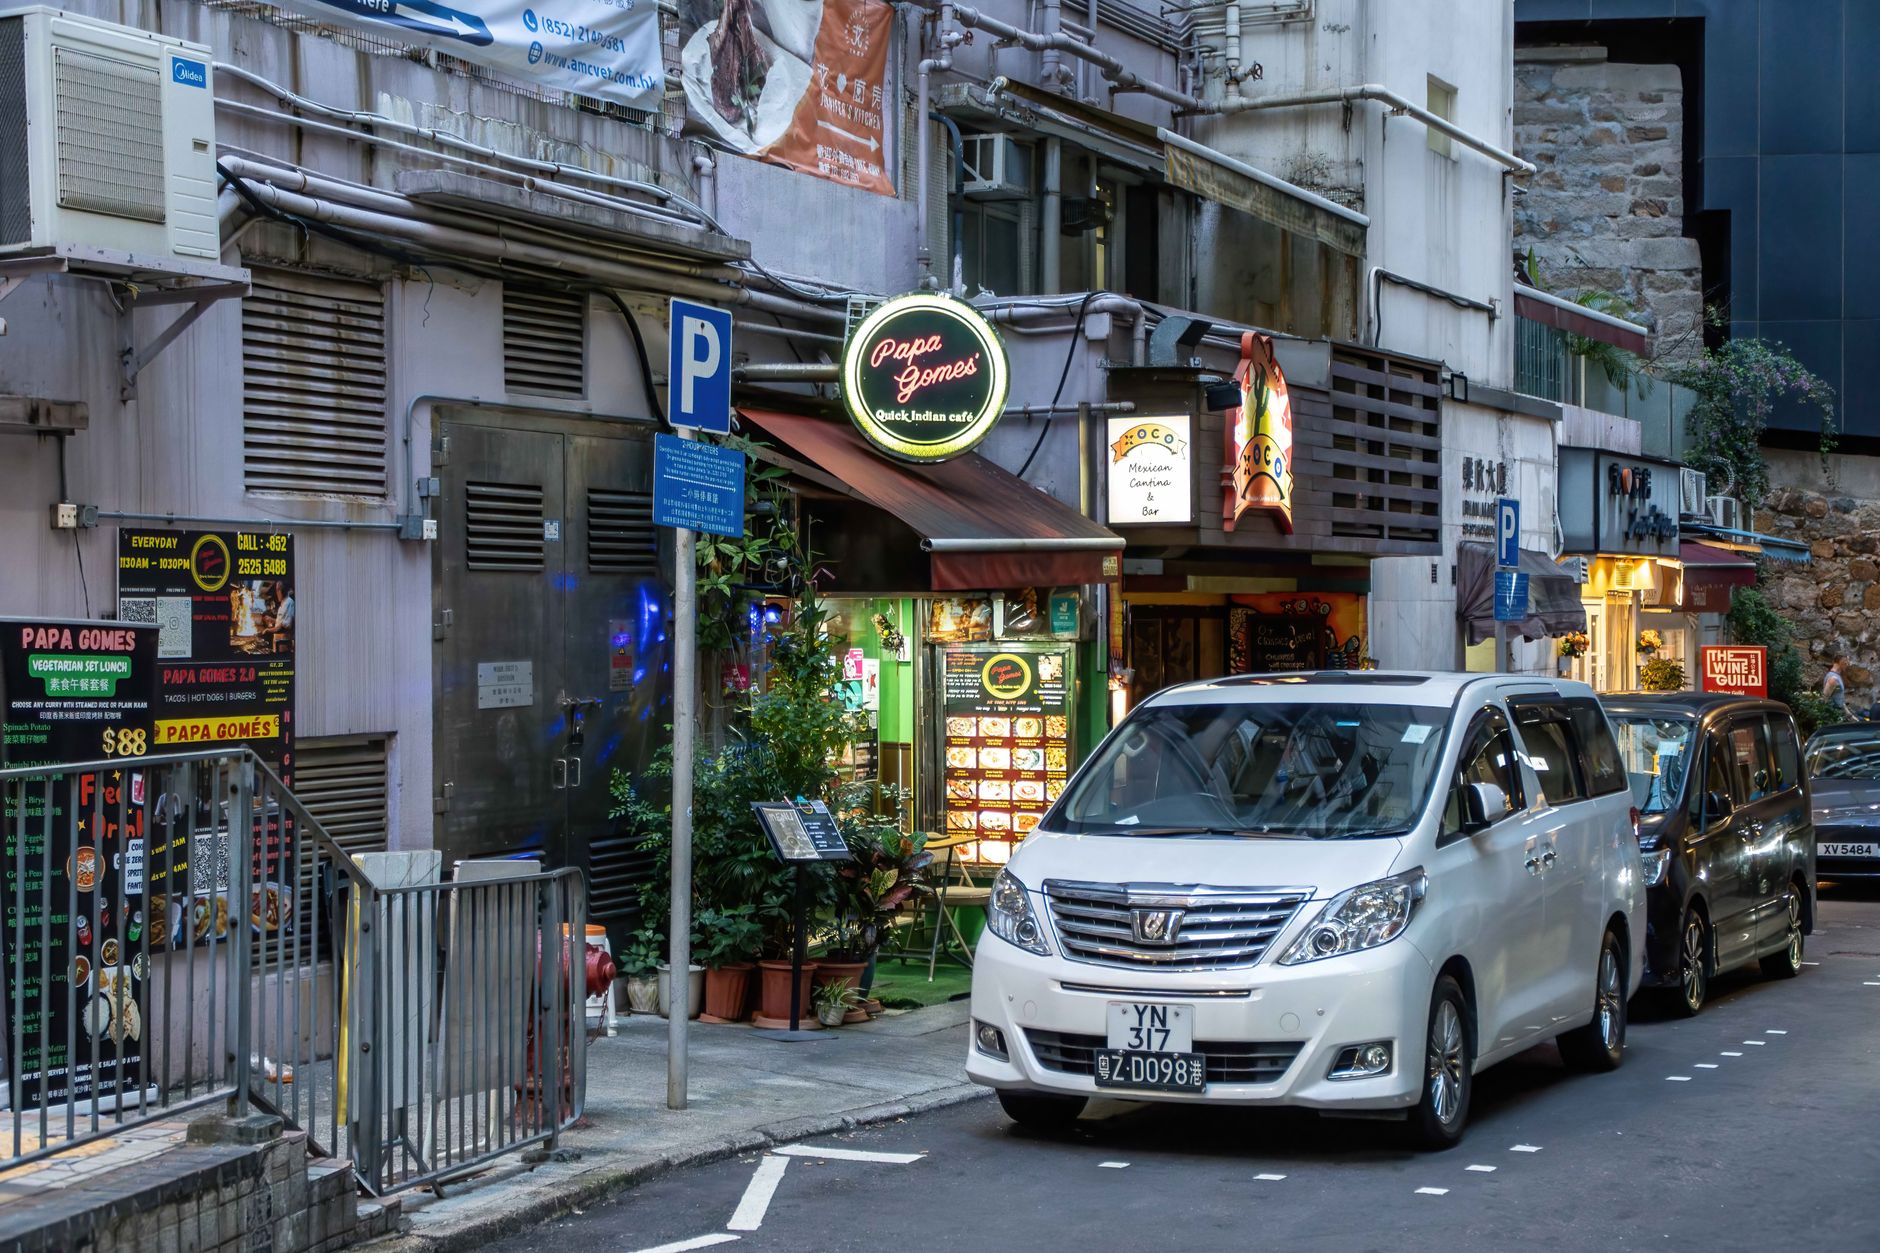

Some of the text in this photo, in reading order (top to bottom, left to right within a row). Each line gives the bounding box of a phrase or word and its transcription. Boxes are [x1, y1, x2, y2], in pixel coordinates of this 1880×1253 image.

[541, 16, 575, 40] (852)
[174, 62, 203, 82] Midea
[545, 52, 657, 90] www.amcvet.com.hk
[853, 105, 881, 130] KITCHEN
[871, 334, 943, 368] Papa
[681, 315, 721, 414] P
[875, 409, 974, 423] Quick Indian café
[1128, 463, 1173, 473] Mexican
[1129, 477, 1172, 488] Cantina
[1146, 492, 1154, 502] &
[1142, 507, 1160, 517] Bar
[1501, 506, 1516, 559] P
[132, 536, 178, 549] EVERYDAY
[237, 534, 258, 551] CALL
[265, 536, 287, 552] +852
[120, 558, 149, 569] 1130AM
[159, 558, 190, 570] 1030PM
[238, 558, 261, 575] 2525
[264, 559, 287, 575] 5488
[22, 628, 136, 651] PAPA GOMES
[1710, 651, 1734, 661] THE
[32, 660, 128, 673] VEGETARIAN SET LUNCH
[1713, 662, 1748, 674] WINE
[163, 667, 256, 684] PAPA GOMES 2.0
[1716, 675, 1759, 686] GUILD
[50, 678, 110, 692] 素食午餐套餐
[164, 695, 186, 703] TACOS
[192, 694, 206, 702] HOT
[207, 693, 225, 701] DOGS
[229, 692, 257, 700] BURGERS
[3, 723, 51, 733] Spinach Potato
[167, 717, 271, 742] PAPA GOMÉS
[102, 726, 147, 759] $88
[1823, 844, 1872, 855] XV 5484
[1133, 1004, 1167, 1028] YN
[1128, 1027, 1171, 1050] 317
